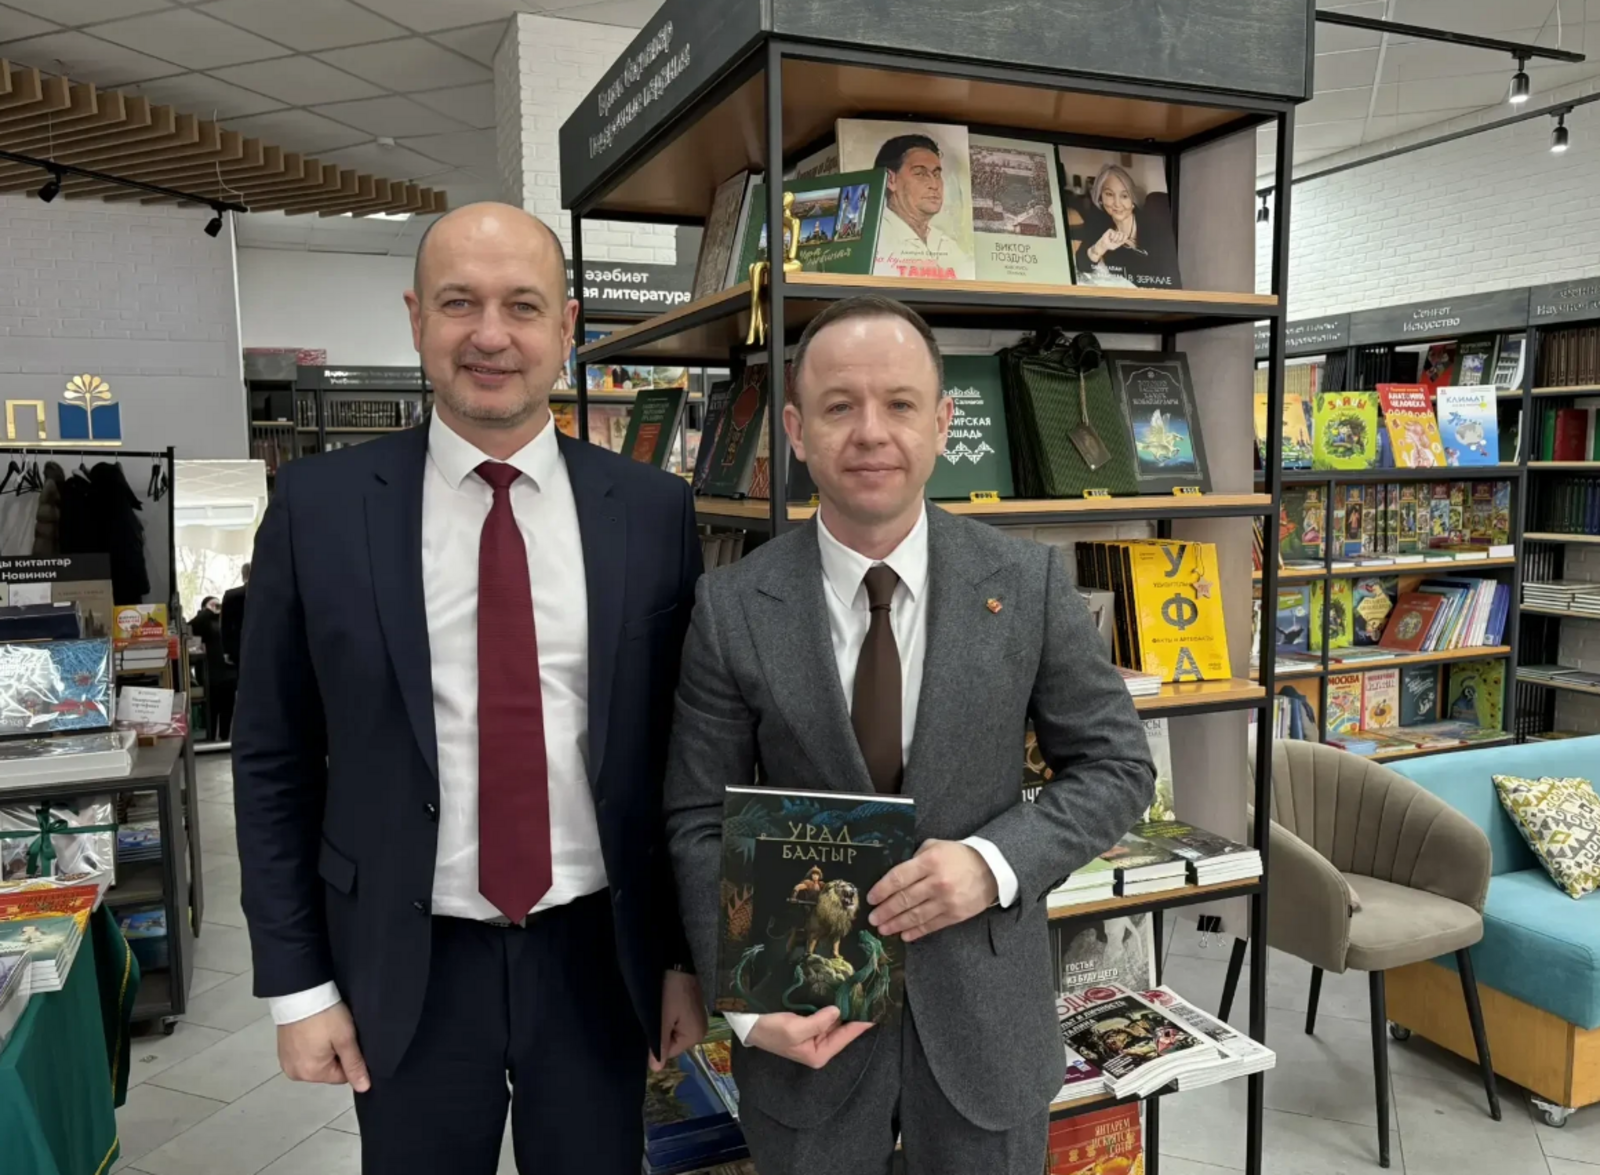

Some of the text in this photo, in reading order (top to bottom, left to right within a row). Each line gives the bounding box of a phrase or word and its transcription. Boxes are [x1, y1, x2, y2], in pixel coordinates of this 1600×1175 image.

[995, 242, 1031, 253] ВИКТОР
[1136, 275, 1172, 285] ЗЕРКАЛЕ
[602, 288, 692, 304] литература
[1403, 317, 1461, 332] Искусство
[1446, 395, 1485, 404] КЛИМАТ
[15, 557, 72, 569] китаптар
[1162, 544, 1187, 578] У
[2, 571, 57, 581] Новинки
[1161, 592, 1199, 631] Ф
[1172, 647, 1205, 682] А
[788, 821, 851, 844] УРАЛ
[782, 845, 858, 864] БААТЫР
[1062, 1018, 1098, 1038] ТАЛИНА
